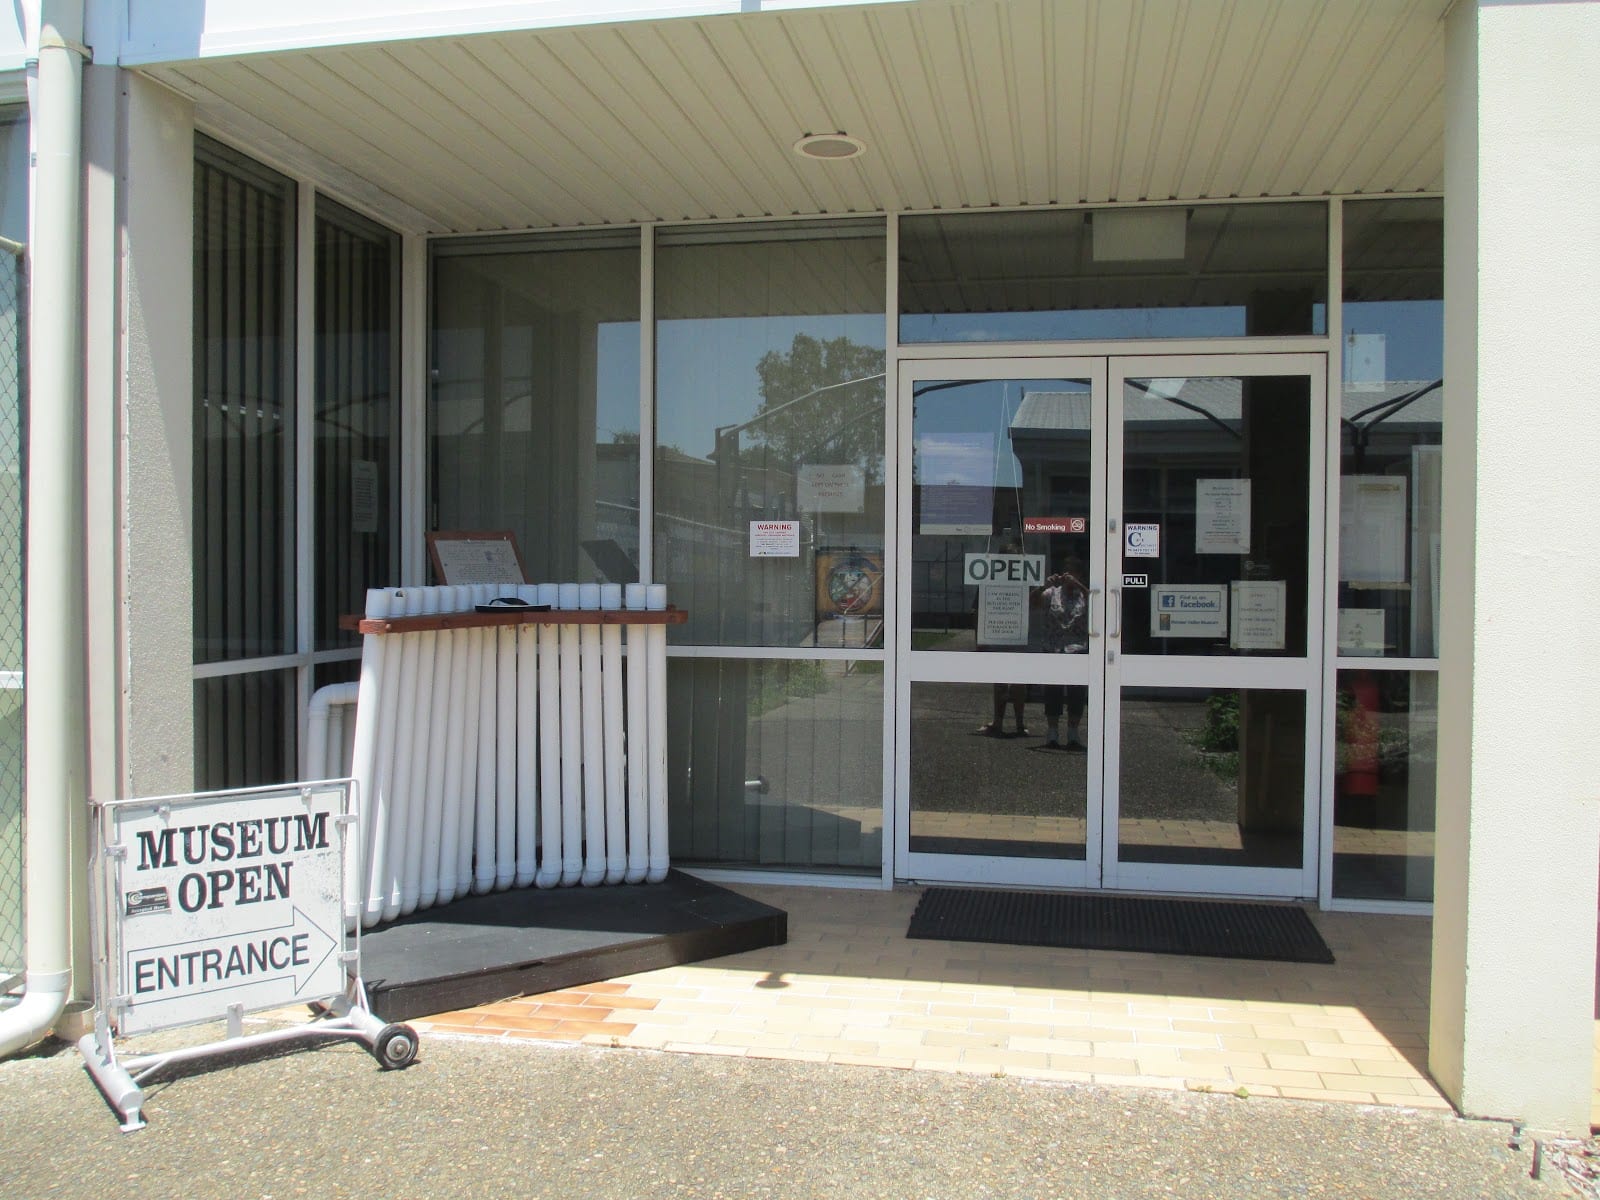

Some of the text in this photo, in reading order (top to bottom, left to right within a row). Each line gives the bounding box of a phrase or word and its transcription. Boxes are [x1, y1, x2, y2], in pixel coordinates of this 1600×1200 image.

[1025, 523, 1066, 532] No Smoking
[968, 558, 1041, 582] OPEN
[1125, 577, 1145, 585] PULL
[1180, 600, 1216, 608] facebook
[136, 811, 330, 872] MUSEUM
[177, 861, 294, 913] OPEN
[135, 932, 310, 994] ENTRANCE
